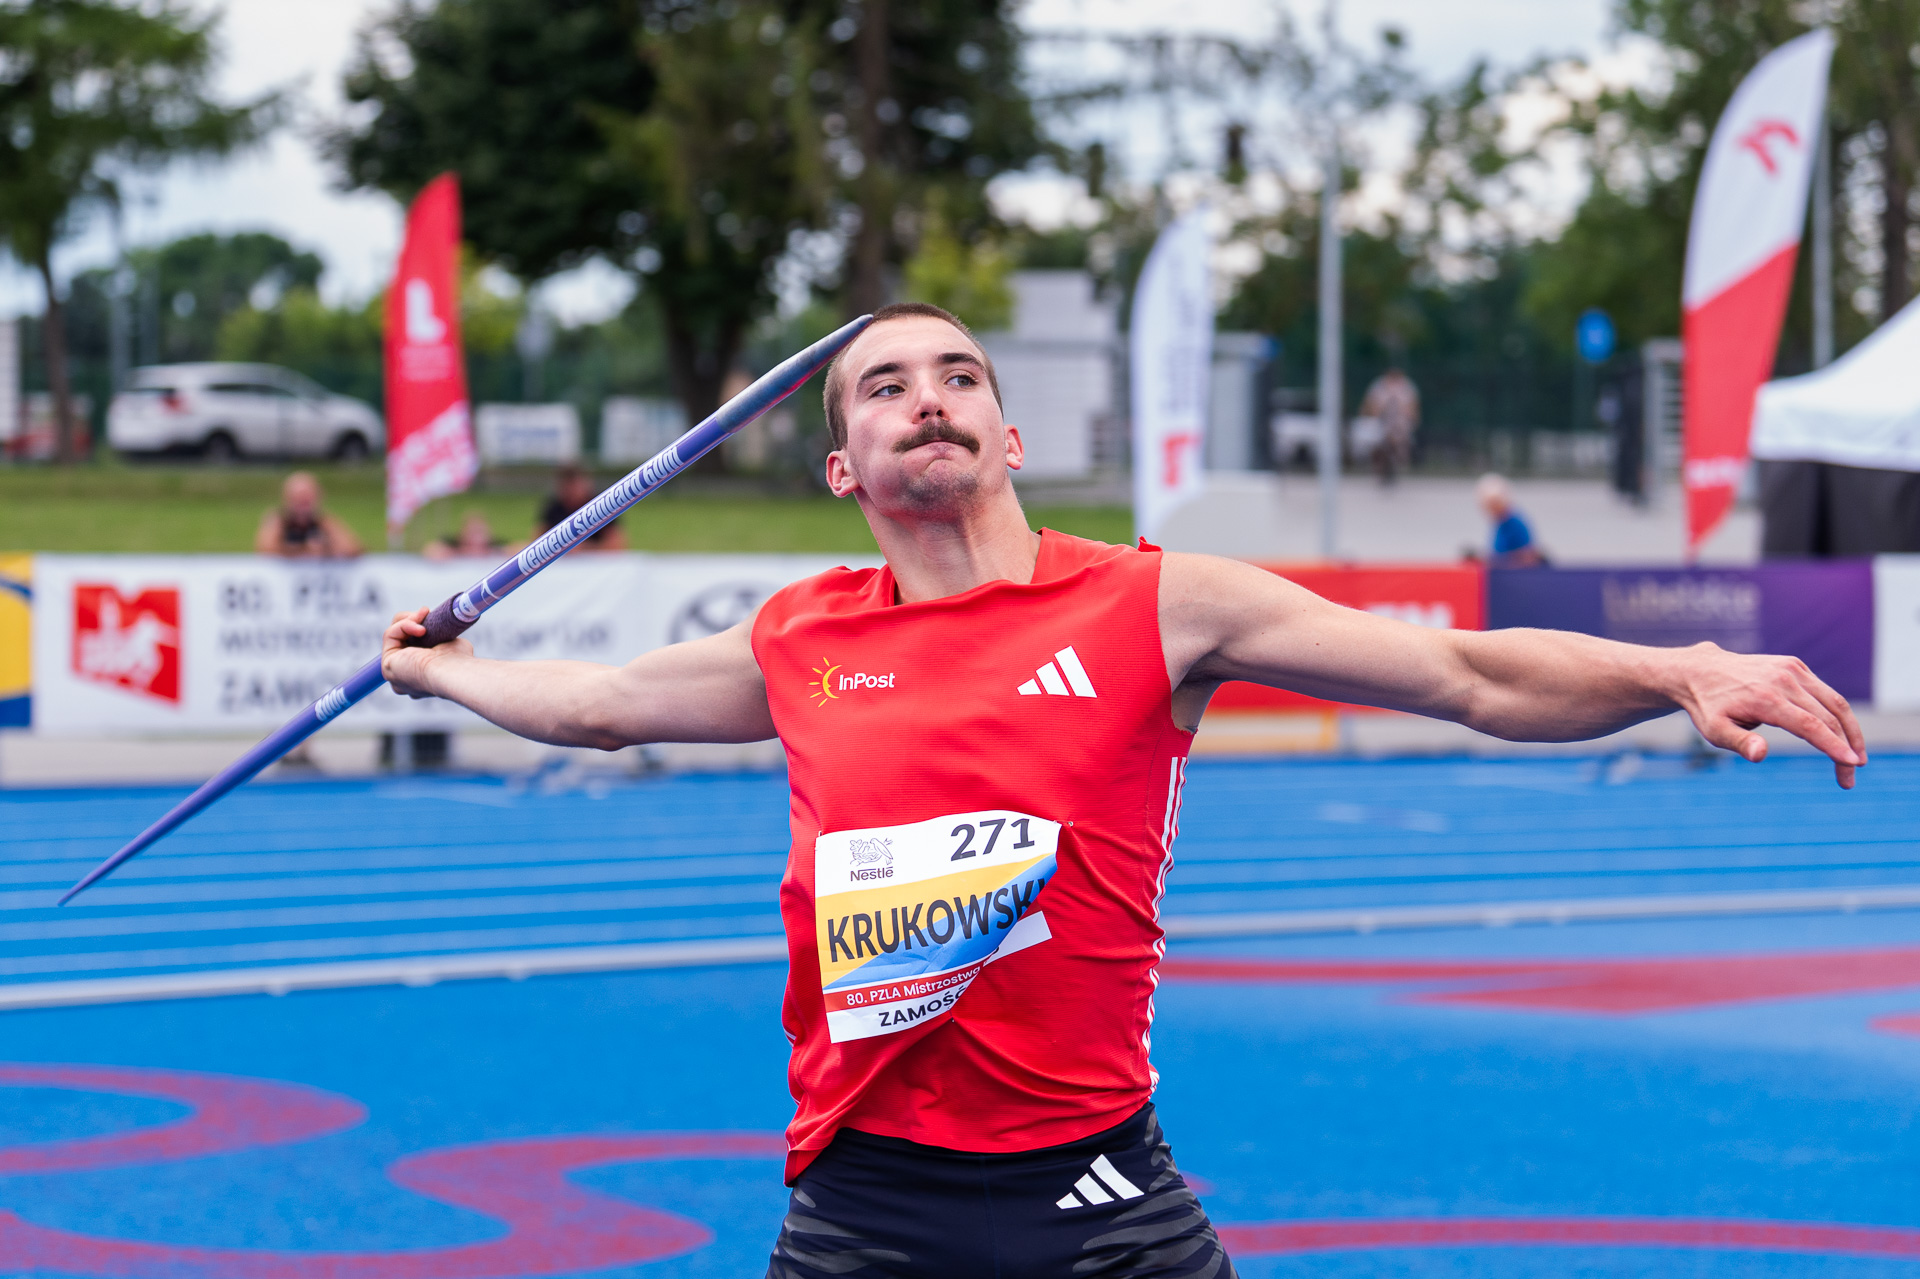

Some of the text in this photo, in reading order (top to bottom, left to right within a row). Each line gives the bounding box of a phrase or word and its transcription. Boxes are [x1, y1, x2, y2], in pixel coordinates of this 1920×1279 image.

[573, 469, 646, 536] standard
[838, 672, 896, 691] InPost
[950, 818, 1035, 862] 271
[850, 866, 894, 882] Nestlé
[846, 965, 981, 1006] 80. PZLA Mistrzostwa
